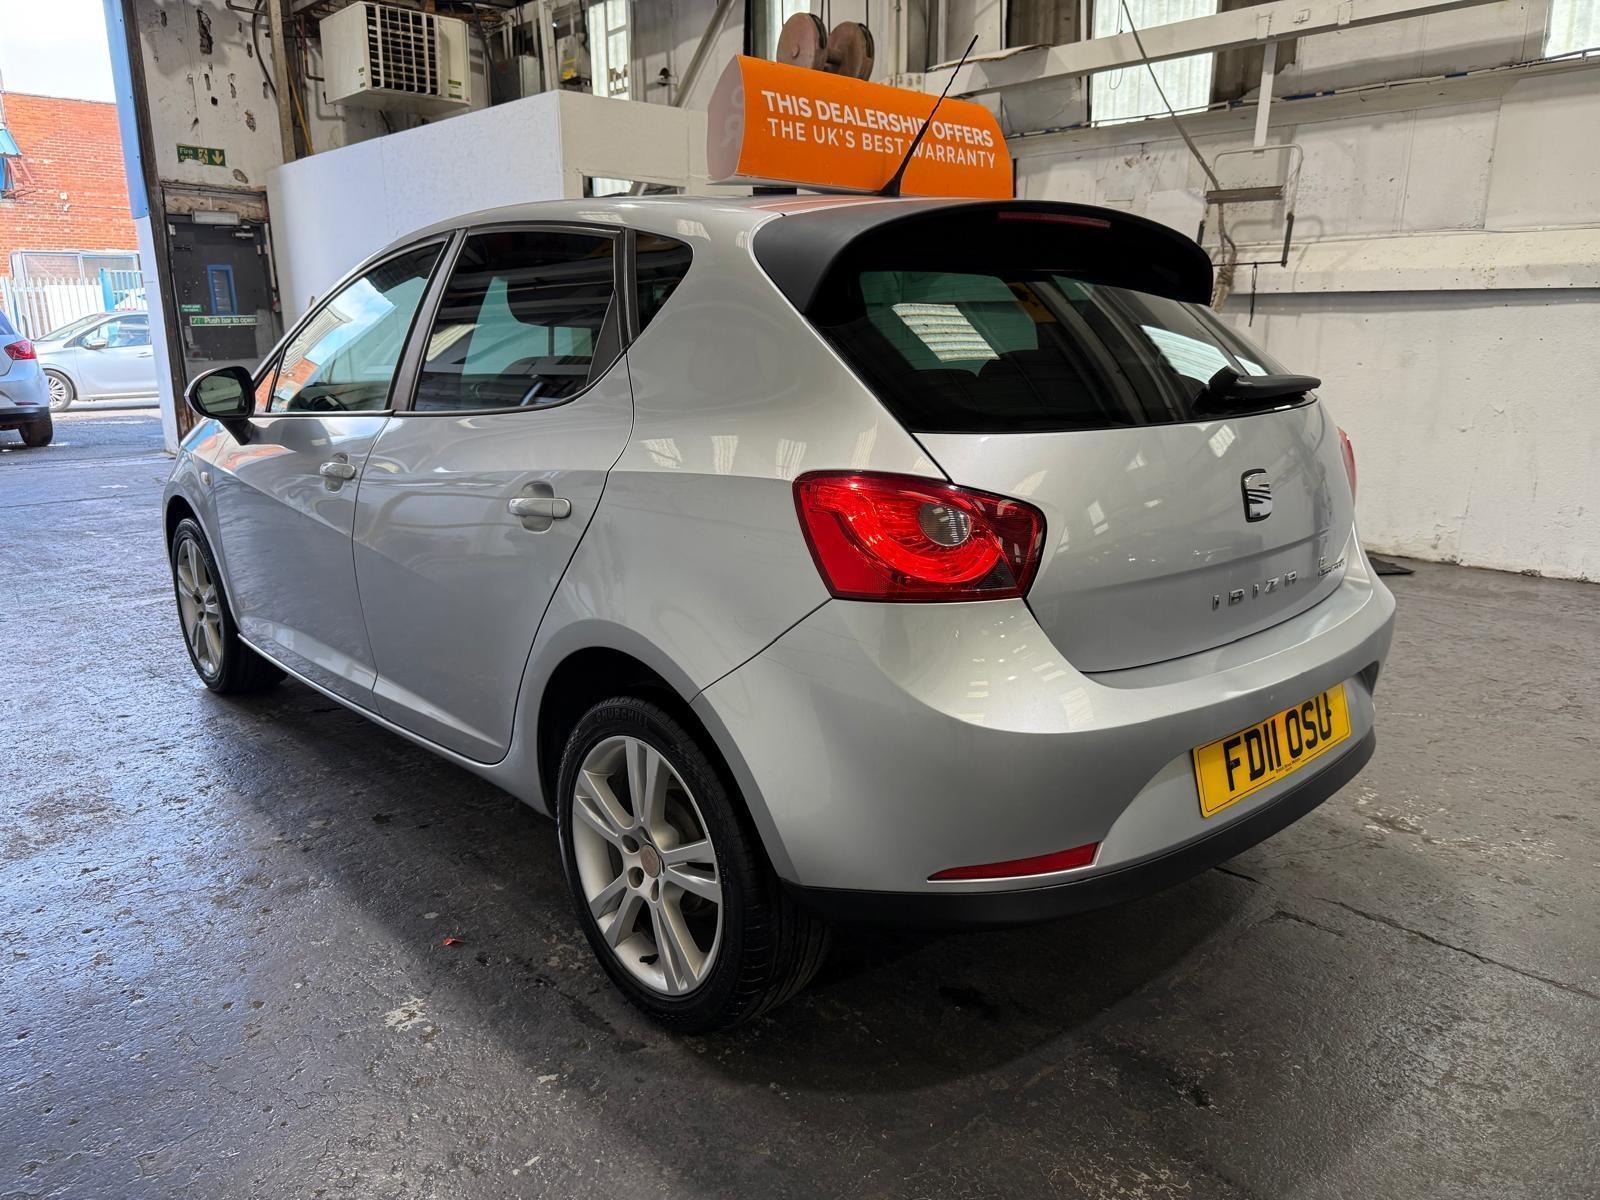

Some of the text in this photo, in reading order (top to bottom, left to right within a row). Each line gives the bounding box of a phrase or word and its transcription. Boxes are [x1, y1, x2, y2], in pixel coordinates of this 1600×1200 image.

[761, 90, 812, 119] THIS
[815, 100, 927, 136] DEALERSHIP
[932, 121, 994, 148] OFFERS
[767, 118, 995, 169] THE UK'S BEST WARRANTY
[1212, 571, 1297, 611] IBIZA
[1223, 692, 1332, 792] FD11 OSU
